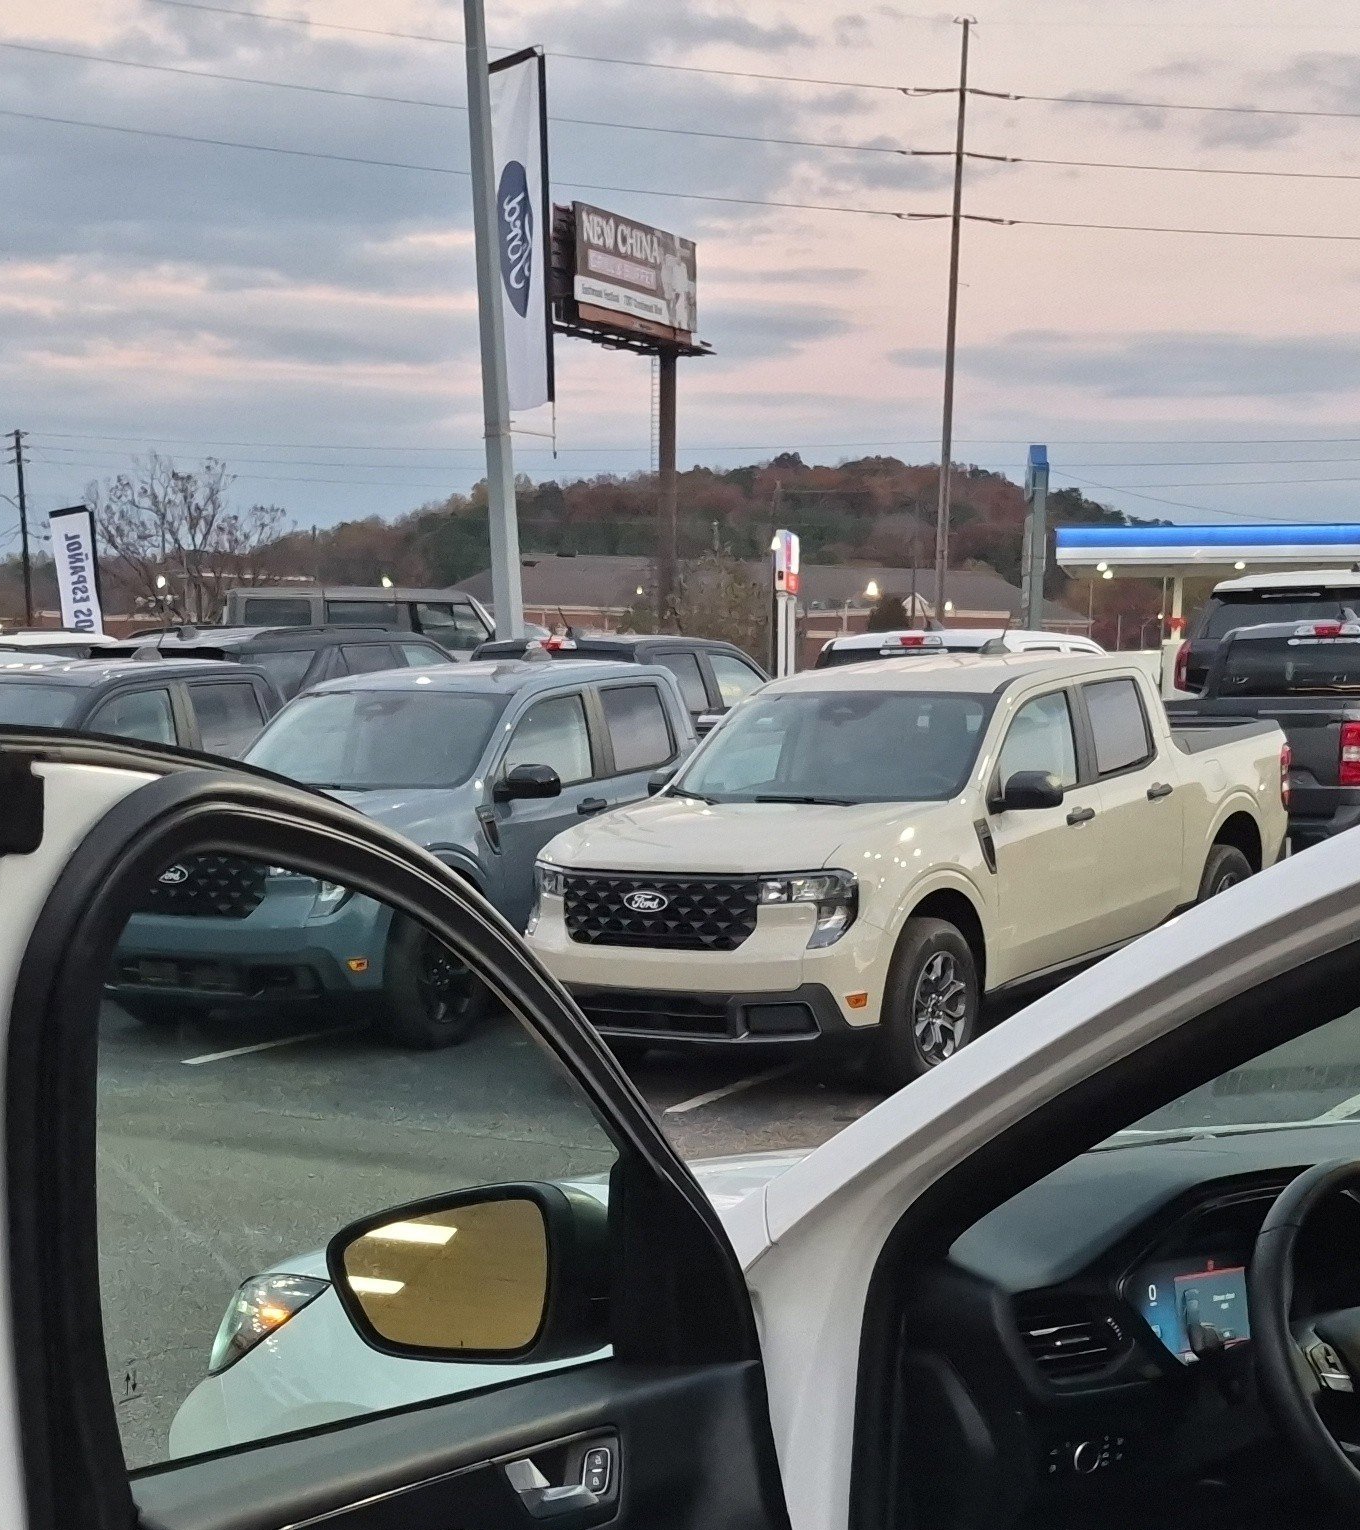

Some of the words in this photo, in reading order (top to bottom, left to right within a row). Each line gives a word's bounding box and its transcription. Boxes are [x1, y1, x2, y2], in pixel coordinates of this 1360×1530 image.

[581, 209, 616, 251] NEW
[616, 223, 661, 265] CHINA
[632, 894, 659, 908] Ford
[1148, 1284, 1157, 1301] 0
